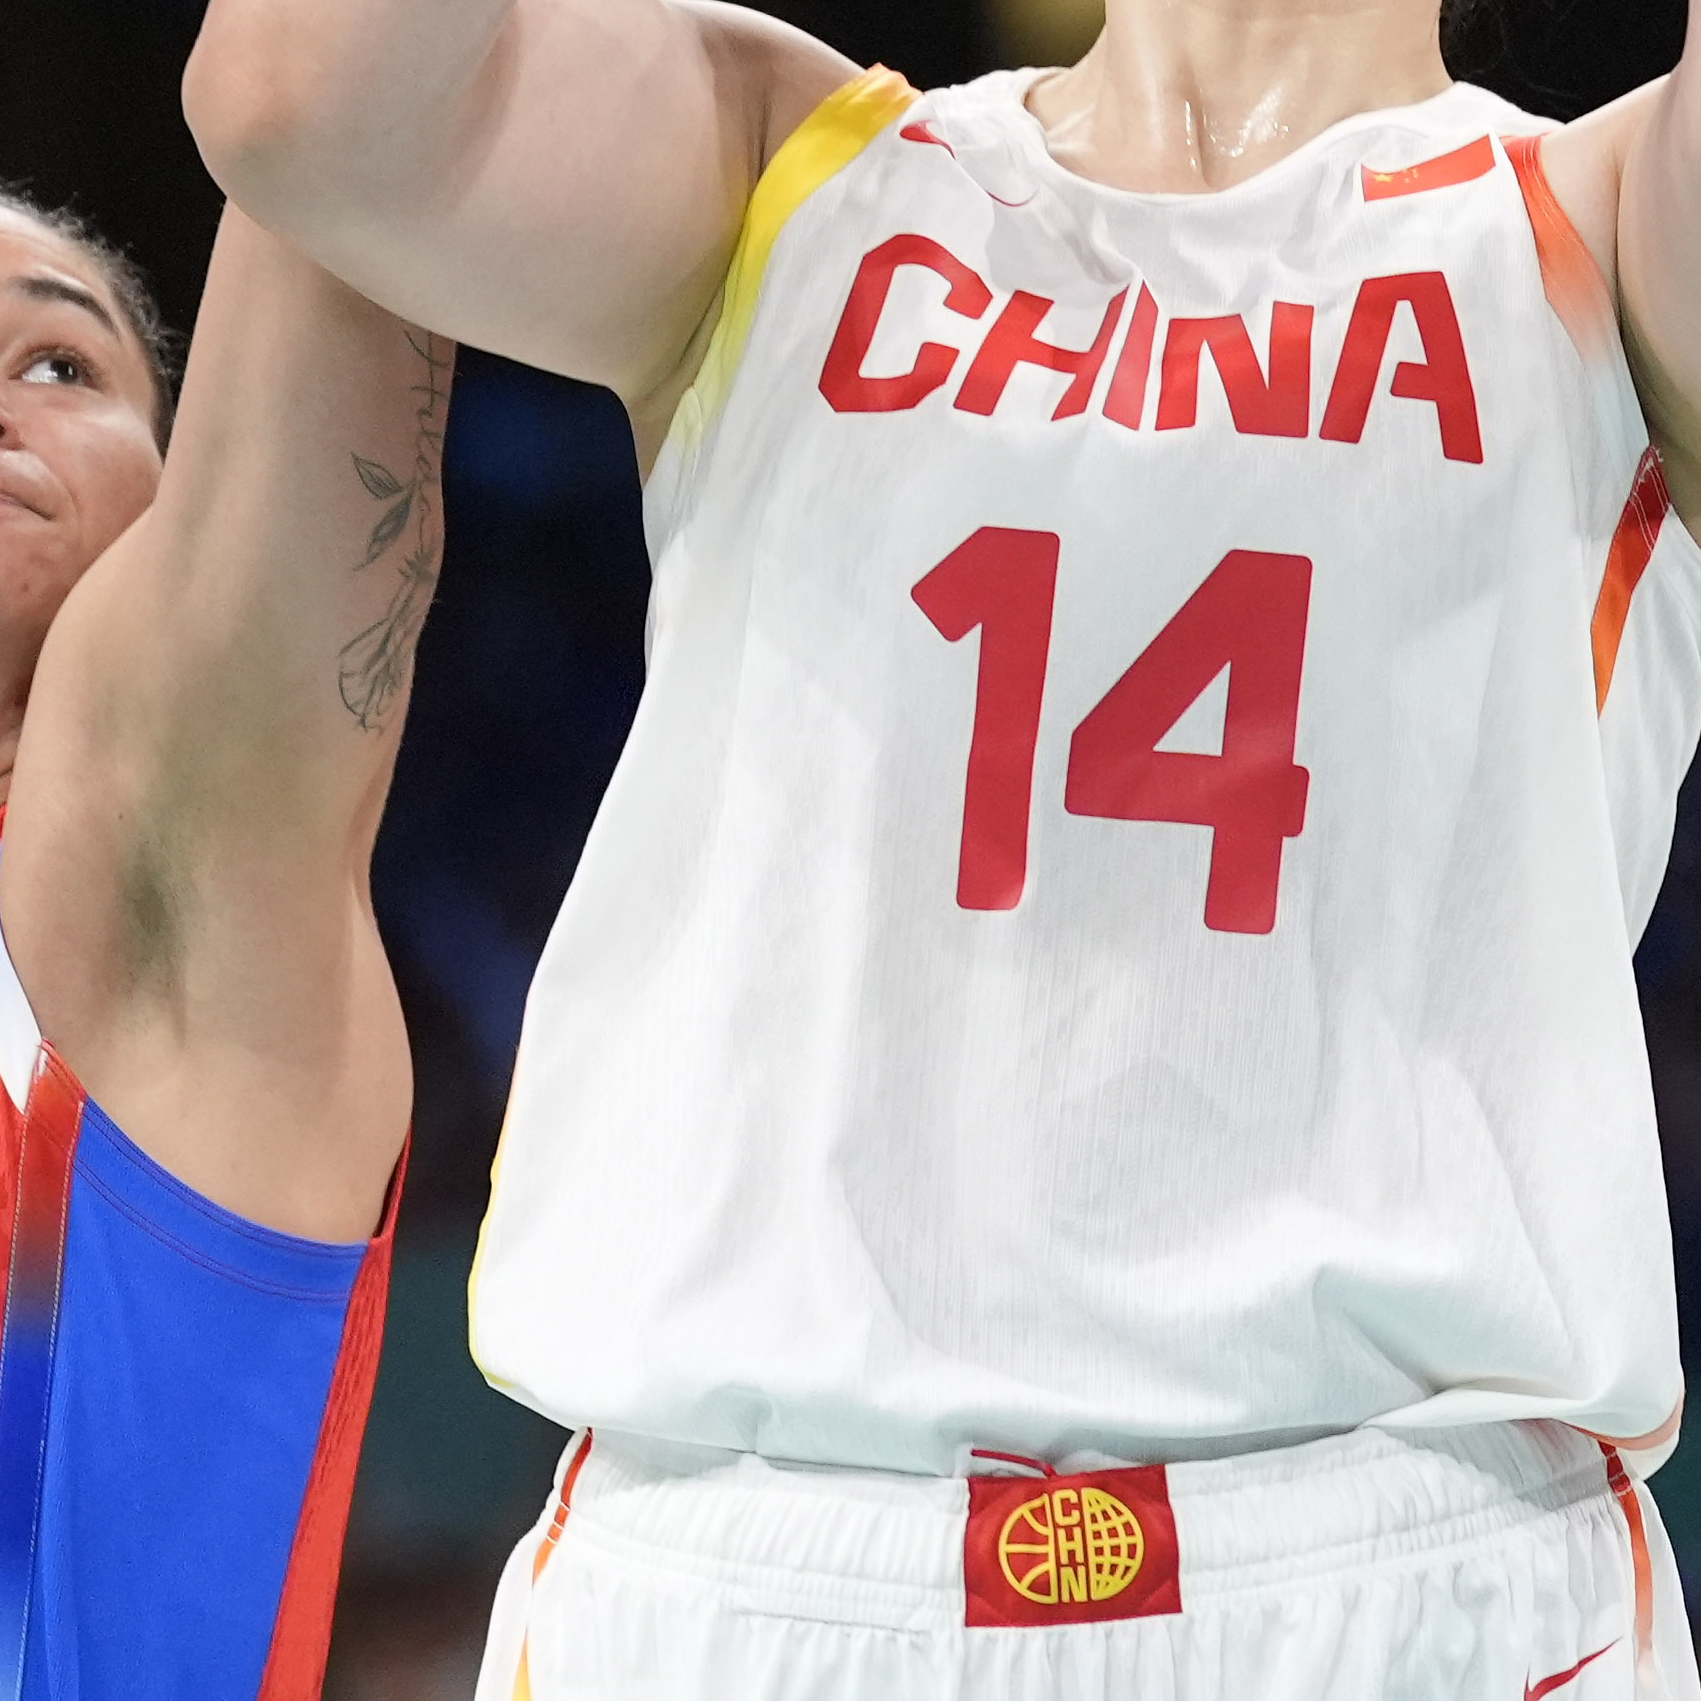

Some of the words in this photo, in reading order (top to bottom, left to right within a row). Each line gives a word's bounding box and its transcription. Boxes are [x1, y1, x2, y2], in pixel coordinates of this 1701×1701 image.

[818, 233, 1484, 465] CHINA
[910, 525, 1313, 935] 14
[1052, 1488, 1088, 1603] CHN
